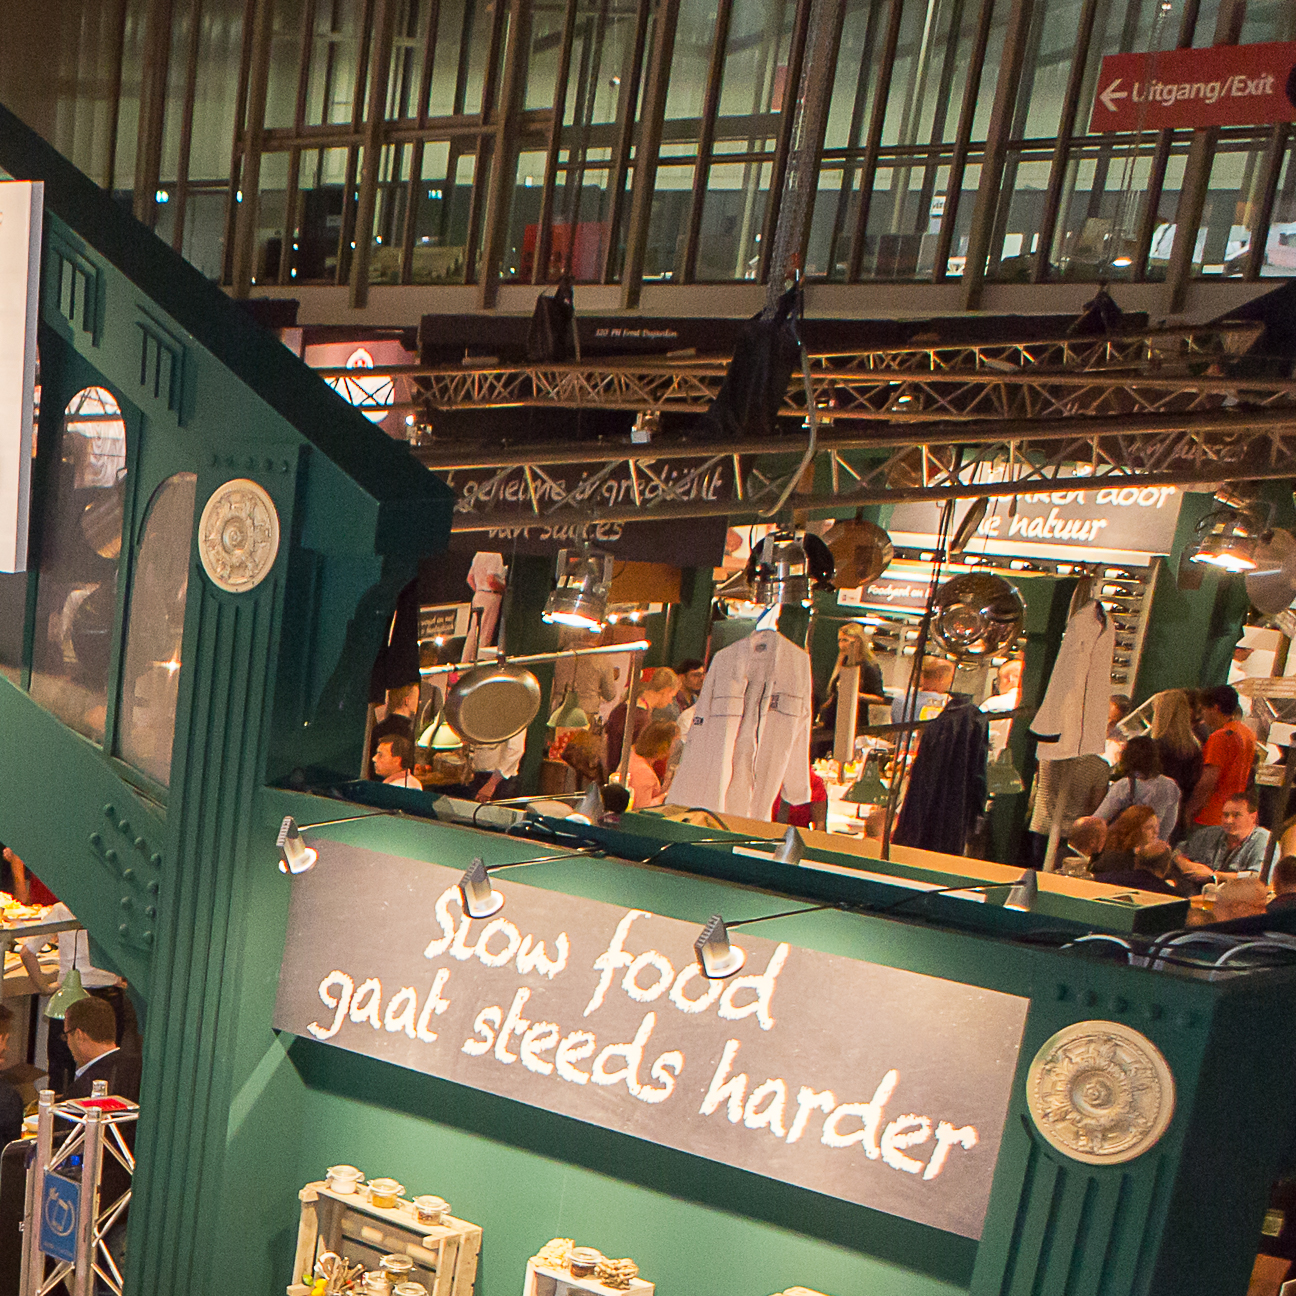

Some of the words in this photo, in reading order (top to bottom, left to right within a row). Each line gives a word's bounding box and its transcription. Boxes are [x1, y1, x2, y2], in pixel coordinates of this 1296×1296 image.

[1131, 73, 1275, 106] Uitgang/Exit
[1008, 507, 1108, 542] natuur
[424, 885, 570, 980] Slow
[582, 908, 792, 1032] food
[306, 966, 452, 1045] gaat
[461, 985, 686, 1106] steeds
[698, 1038, 982, 1182] harder
